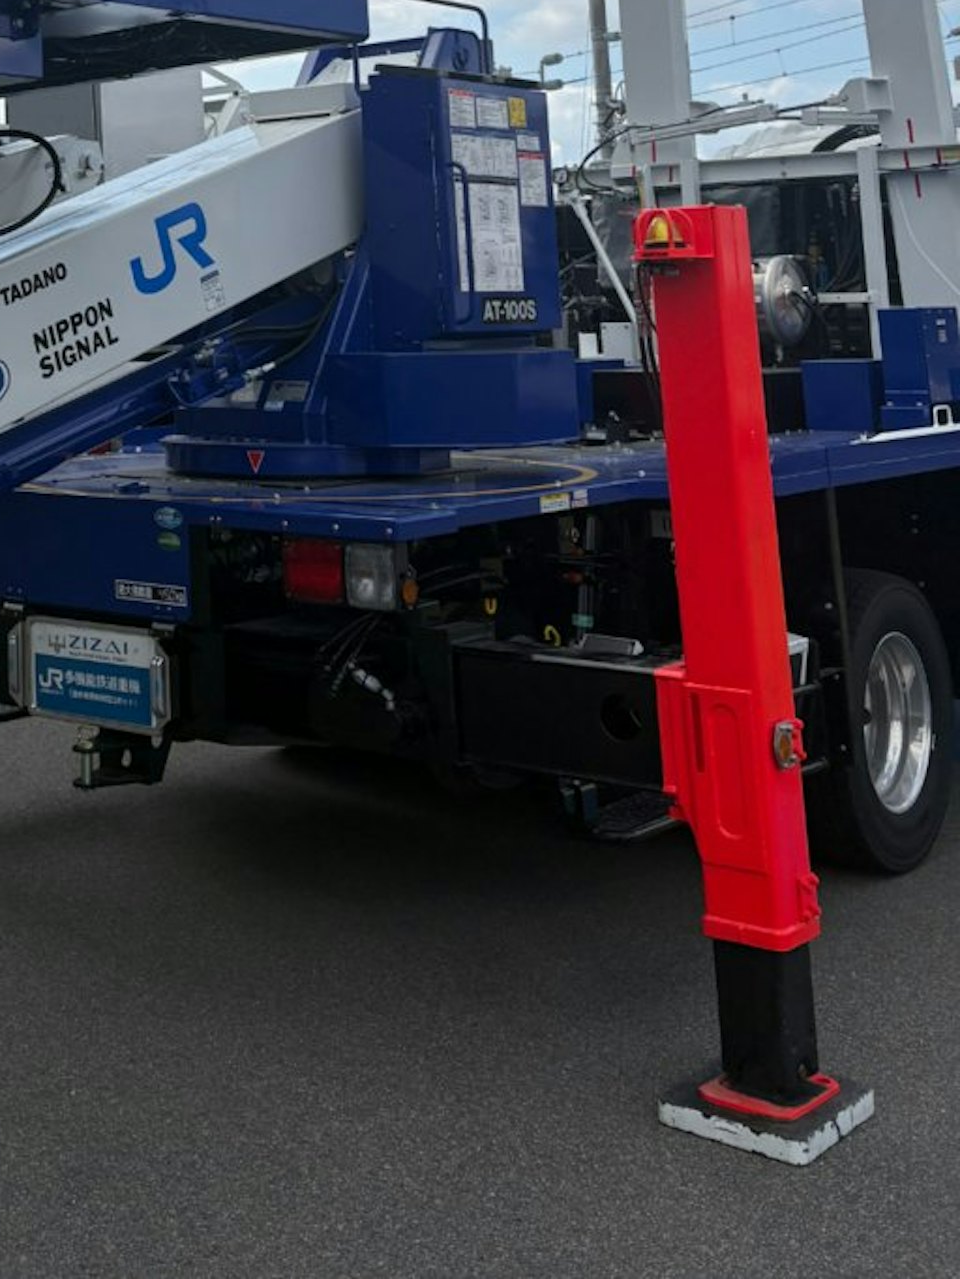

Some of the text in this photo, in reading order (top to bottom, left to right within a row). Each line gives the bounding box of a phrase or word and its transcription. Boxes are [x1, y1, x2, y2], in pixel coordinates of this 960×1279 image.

[130, 202, 215, 295] JR
[0, 262, 68, 306] TADANO
[33, 298, 114, 353] NIPPON
[483, 299, 538, 321] AT-100S
[39, 325, 119, 379] SIGNAL
[69, 634, 129, 655] ZIZAI
[38, 667, 64, 690] JR
